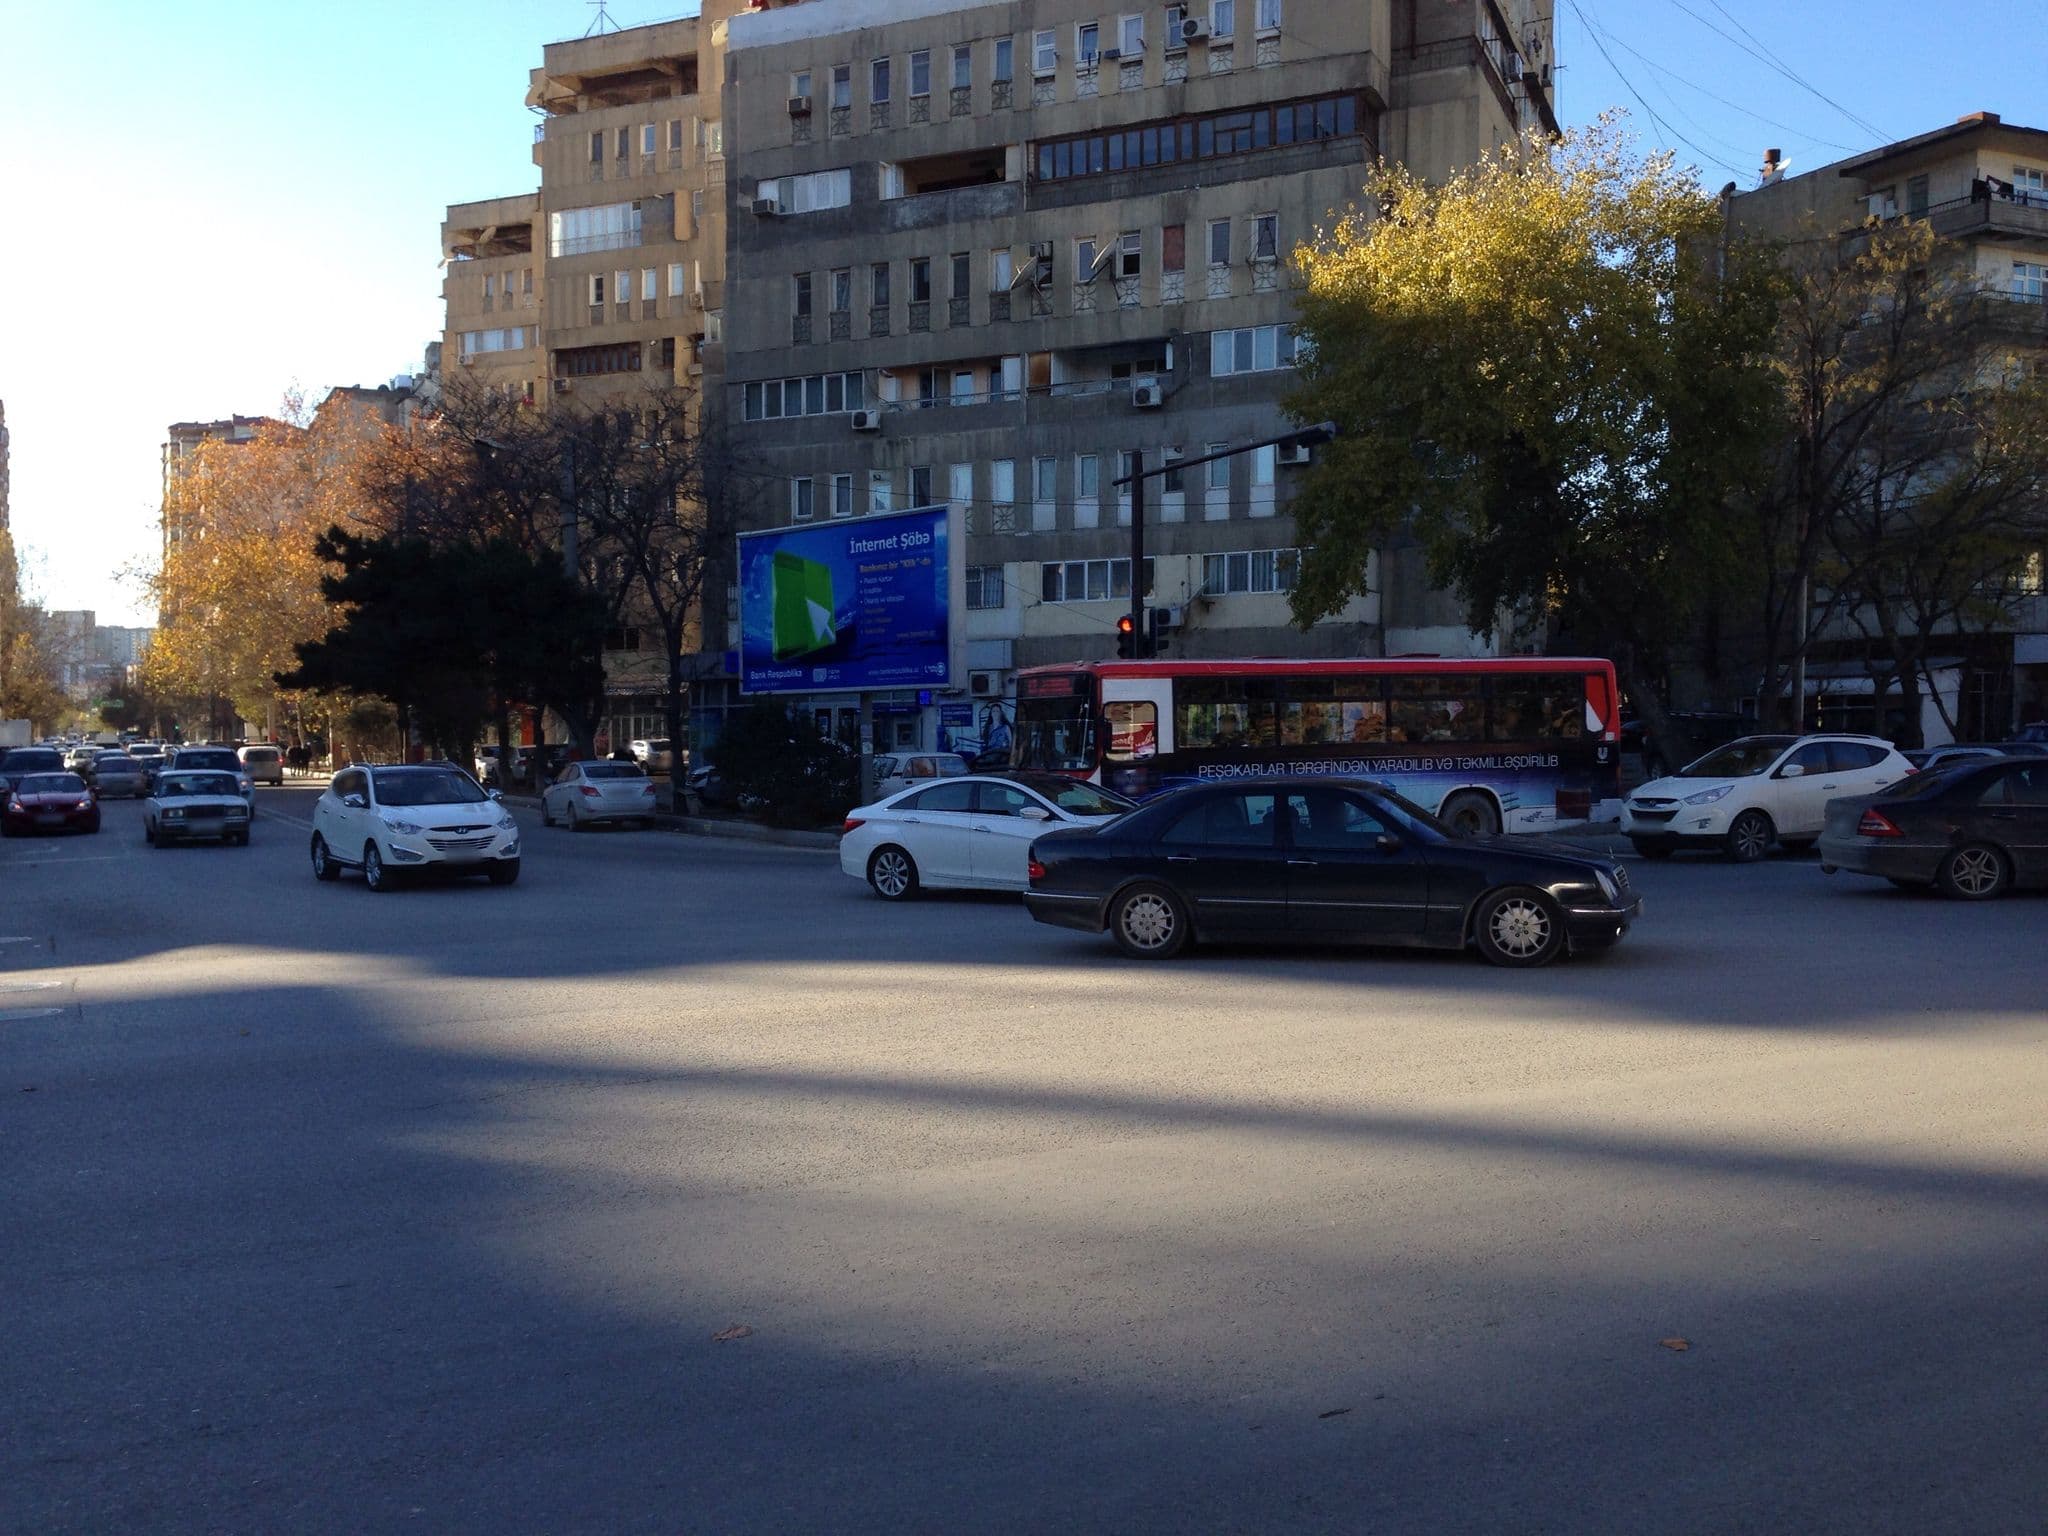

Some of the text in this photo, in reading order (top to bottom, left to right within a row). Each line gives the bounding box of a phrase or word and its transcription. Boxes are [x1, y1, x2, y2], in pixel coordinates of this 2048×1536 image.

[850, 531, 930, 554] İnternet Şöbə
[1198, 762, 1286, 781] PEŞƏKARLAR
[1287, 759, 1370, 775] TƏRƏFİNDƏN
[1372, 757, 1434, 772] YARADILIB
[1435, 757, 1453, 770] VƏ
